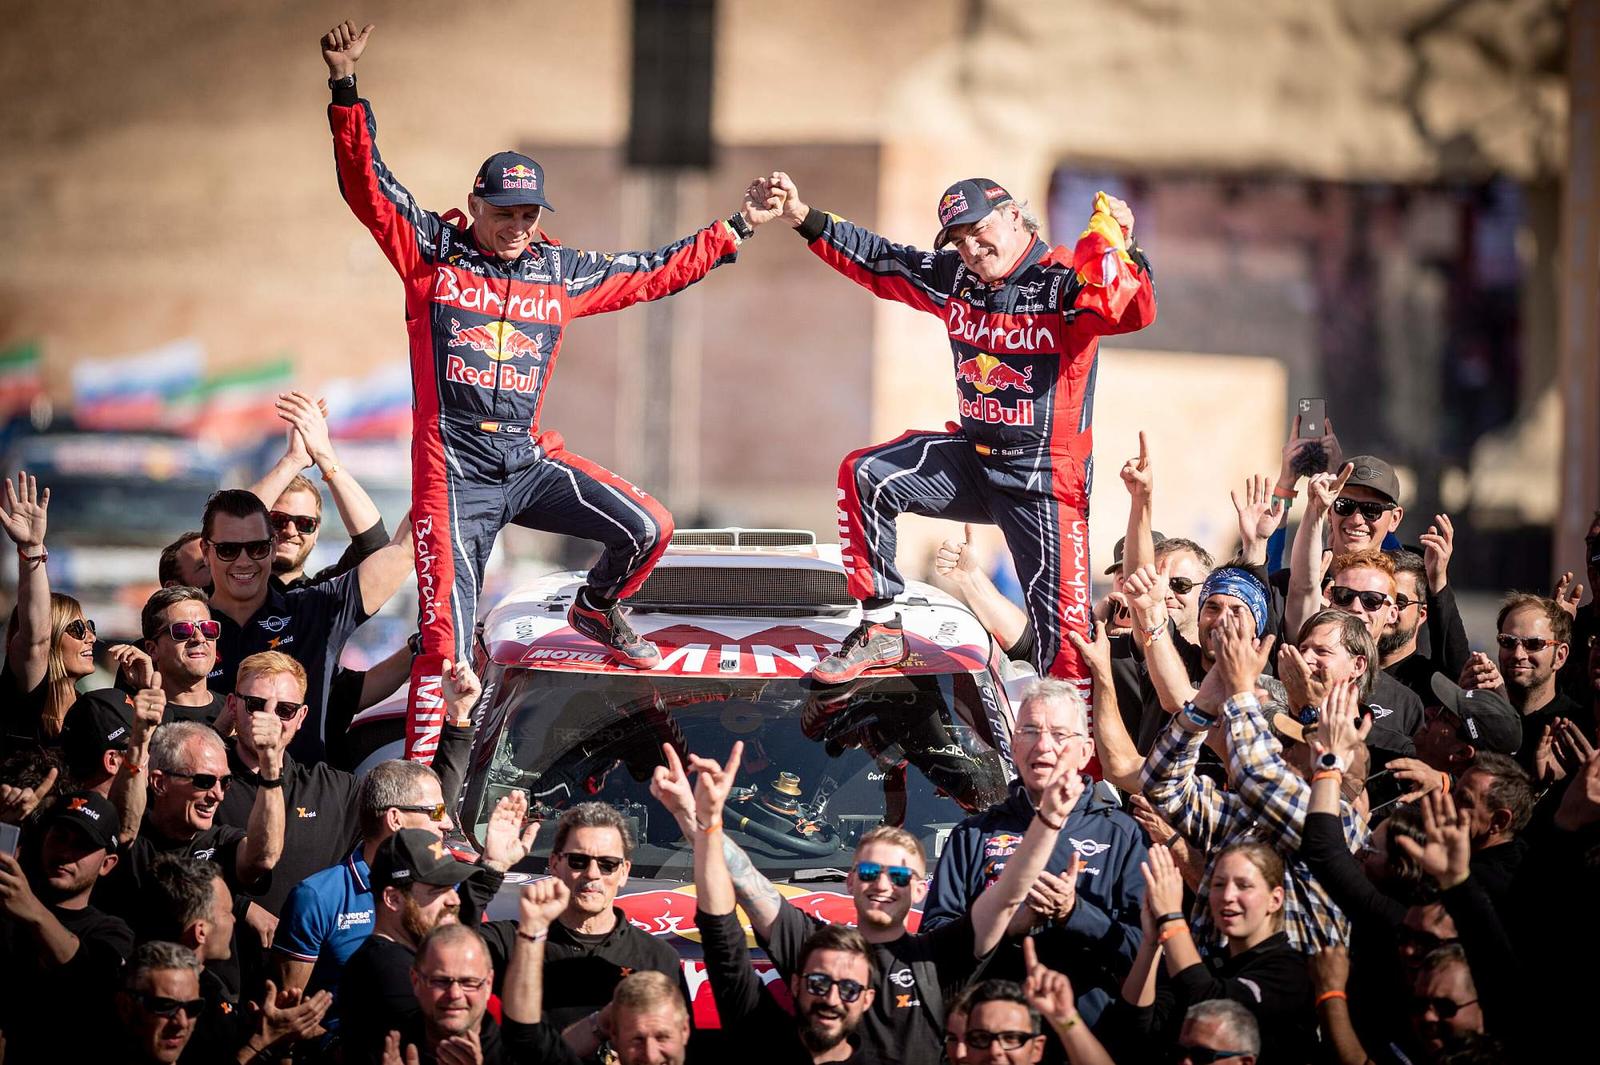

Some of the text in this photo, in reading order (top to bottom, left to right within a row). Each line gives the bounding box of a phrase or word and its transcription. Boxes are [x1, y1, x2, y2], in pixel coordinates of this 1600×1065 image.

[503, 179, 537, 190] Red Bull
[951, 200, 969, 216] Bull
[434, 266, 562, 322] Bahrain
[1048, 275, 1061, 310] sparco
[949, 301, 1055, 350] Bahrain
[446, 354, 540, 394] Red Bull
[984, 398, 1035, 427] Bull
[1001, 448, 1024, 457] Sainz
[416, 515, 437, 625] Bahrain
[1064, 520, 1087, 624] Bahrain
[527, 649, 606, 662] MOTUL
